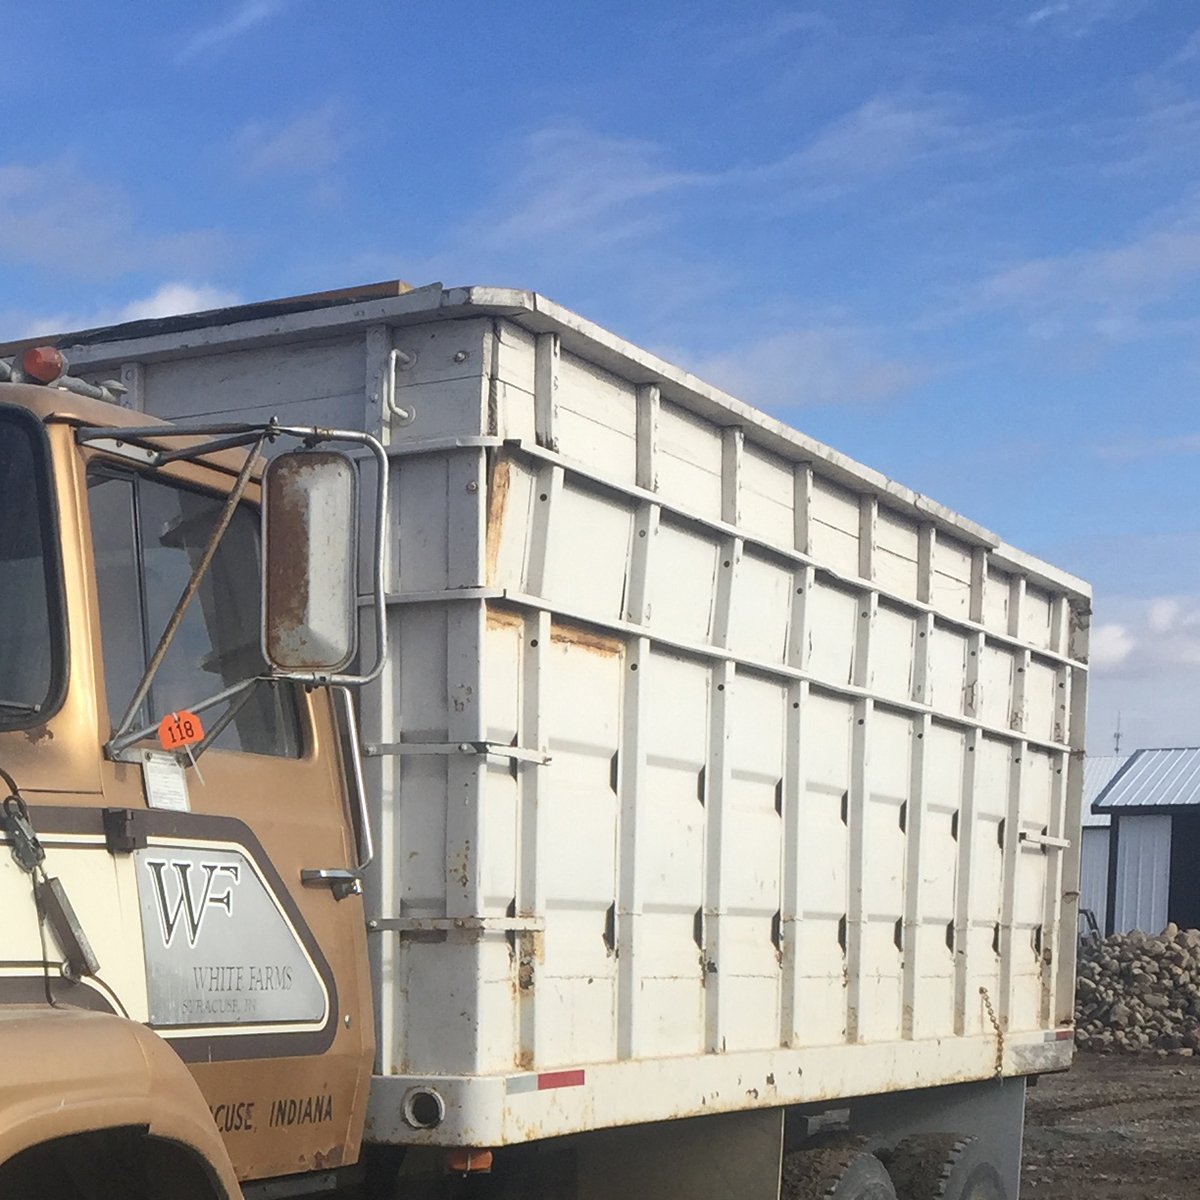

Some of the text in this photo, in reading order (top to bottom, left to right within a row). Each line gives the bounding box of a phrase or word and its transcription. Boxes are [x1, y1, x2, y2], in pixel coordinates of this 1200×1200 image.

[167, 721, 194, 743] 118
[193, 966, 294, 992] WHITE FARMS
[269, 1095, 332, 1127] INDIANA
